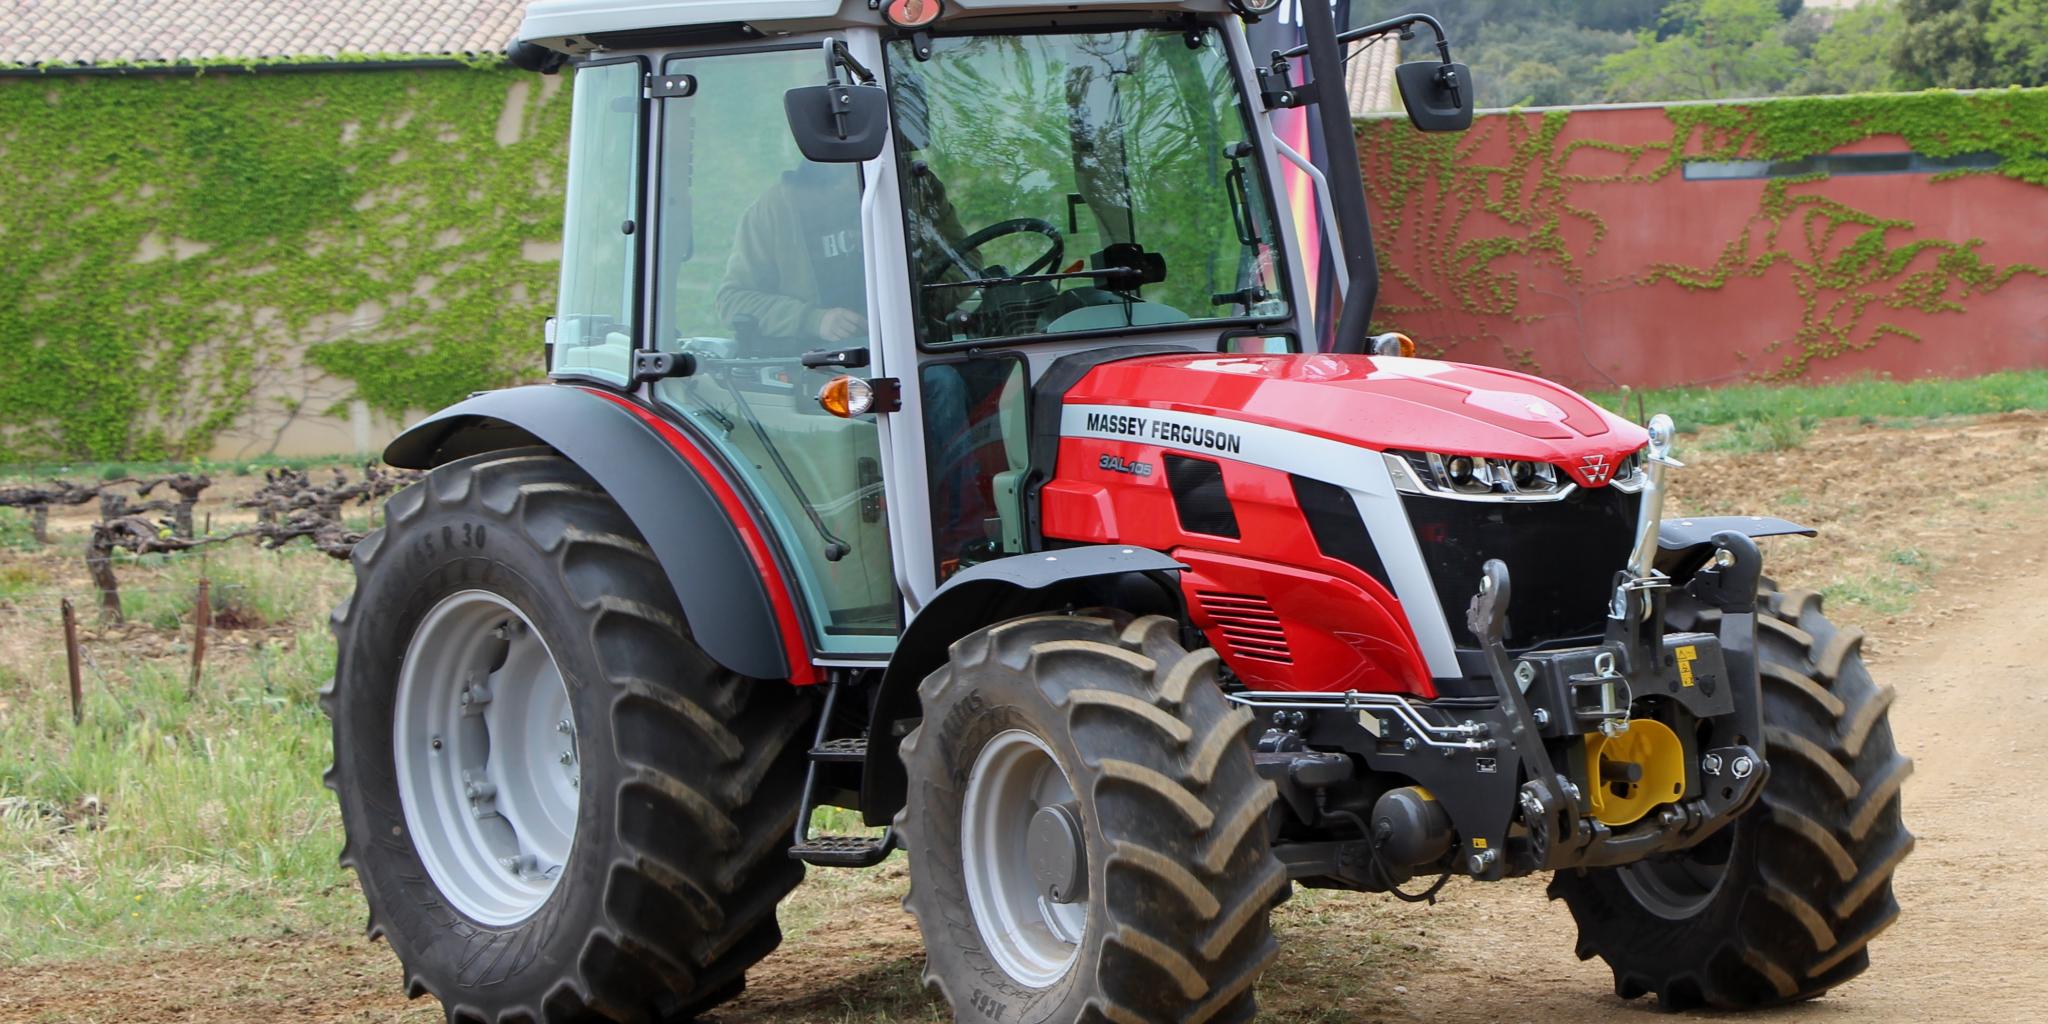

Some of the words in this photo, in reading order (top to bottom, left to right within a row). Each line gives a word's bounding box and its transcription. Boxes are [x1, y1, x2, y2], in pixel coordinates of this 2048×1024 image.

[1087, 413, 1147, 436] MASSEY
[1151, 420, 1240, 453] FERGUSON
[463, 522, 486, 549] 30
